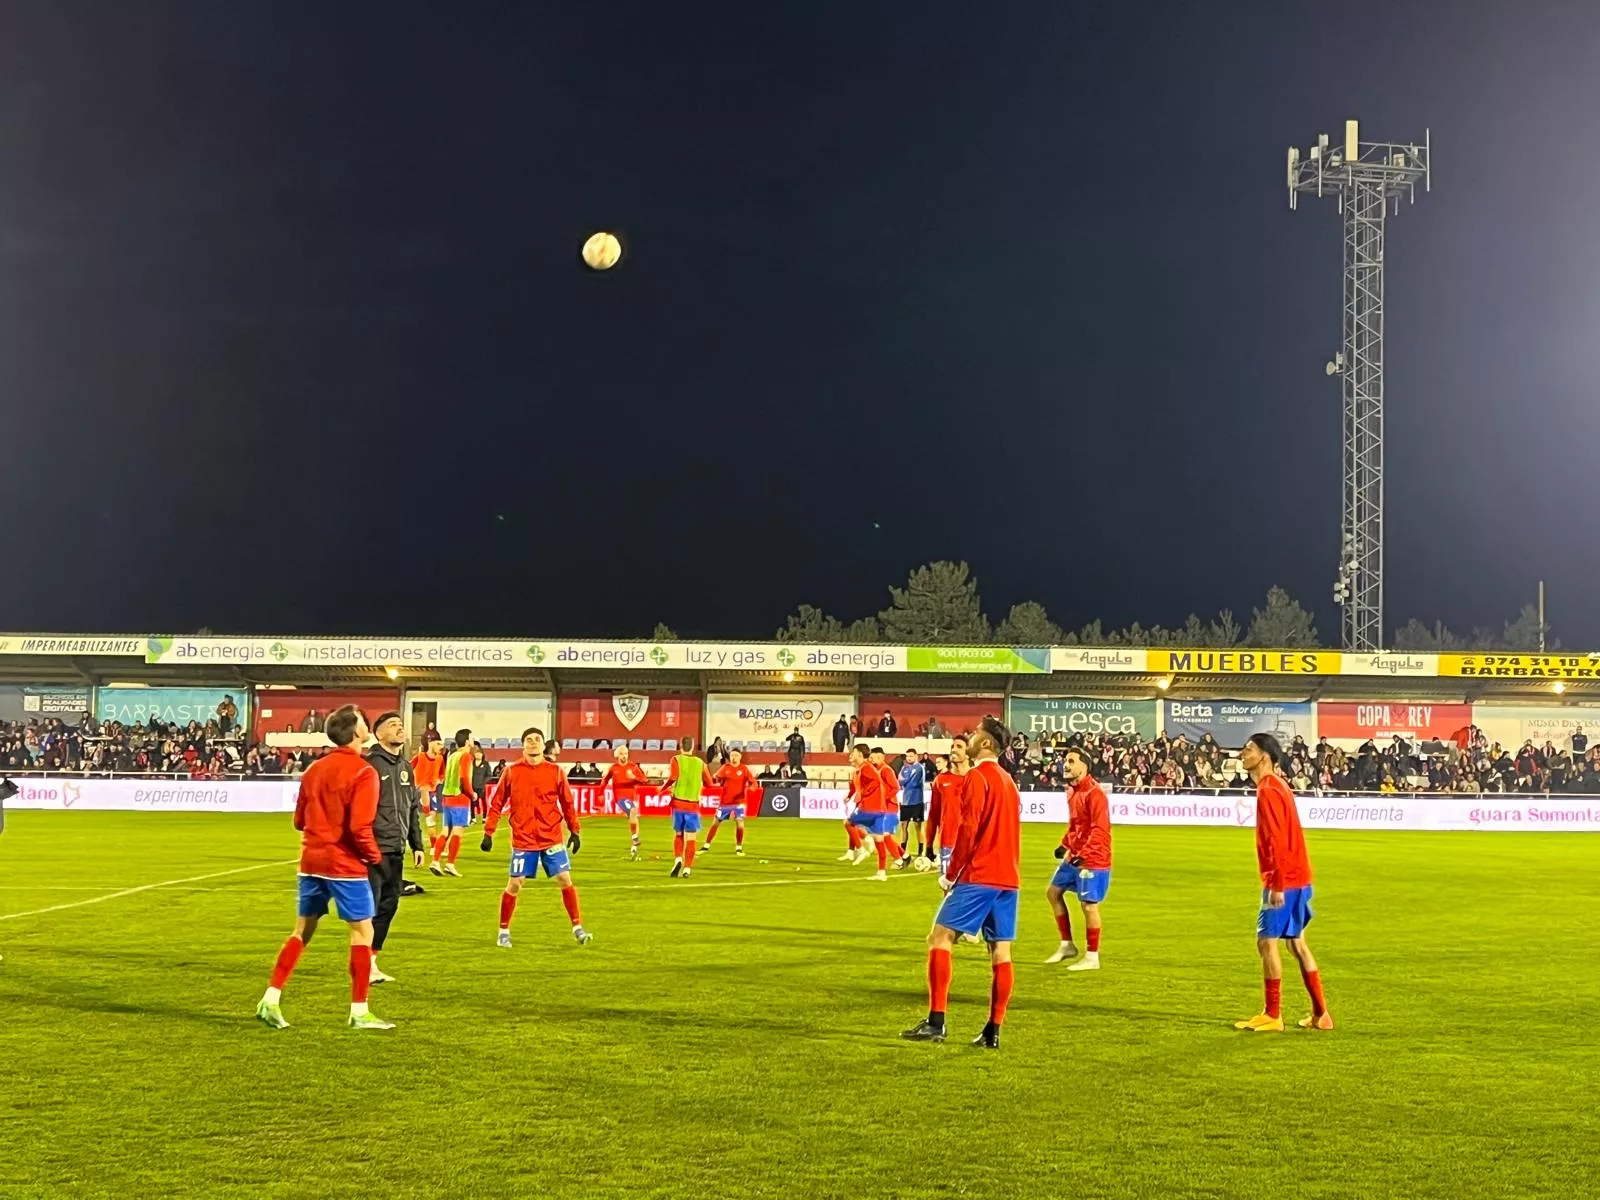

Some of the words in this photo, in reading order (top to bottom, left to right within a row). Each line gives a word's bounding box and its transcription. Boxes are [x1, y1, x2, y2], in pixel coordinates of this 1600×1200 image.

[21, 640, 140, 652] IMPERMEABILIZANTES
[303, 643, 422, 660] instalaciones
[428, 645, 513, 661] eléctricas
[686, 648, 712, 663] luz
[717, 652, 727, 666] y
[732, 651, 766, 667] gas
[1169, 652, 1318, 673] MUEBLES
[1484, 658, 1521, 666] 974
[1530, 658, 1550, 666] 31
[738, 708, 814, 720] BARBASTRO
[1171, 702, 1214, 717] Berta
[1221, 704, 1249, 715] sabor
[1250, 705, 1263, 715] de
[1264, 707, 1285, 715] mar
[1357, 706, 1391, 727] COPA
[1408, 706, 1432, 728] REY
[134, 787, 229, 805] experimenta
[1135, 802, 1230, 818] Somontano
[1308, 804, 1404, 822] experimenta
[1469, 808, 1521, 825] guara
[513, 858, 525, 873] 11
